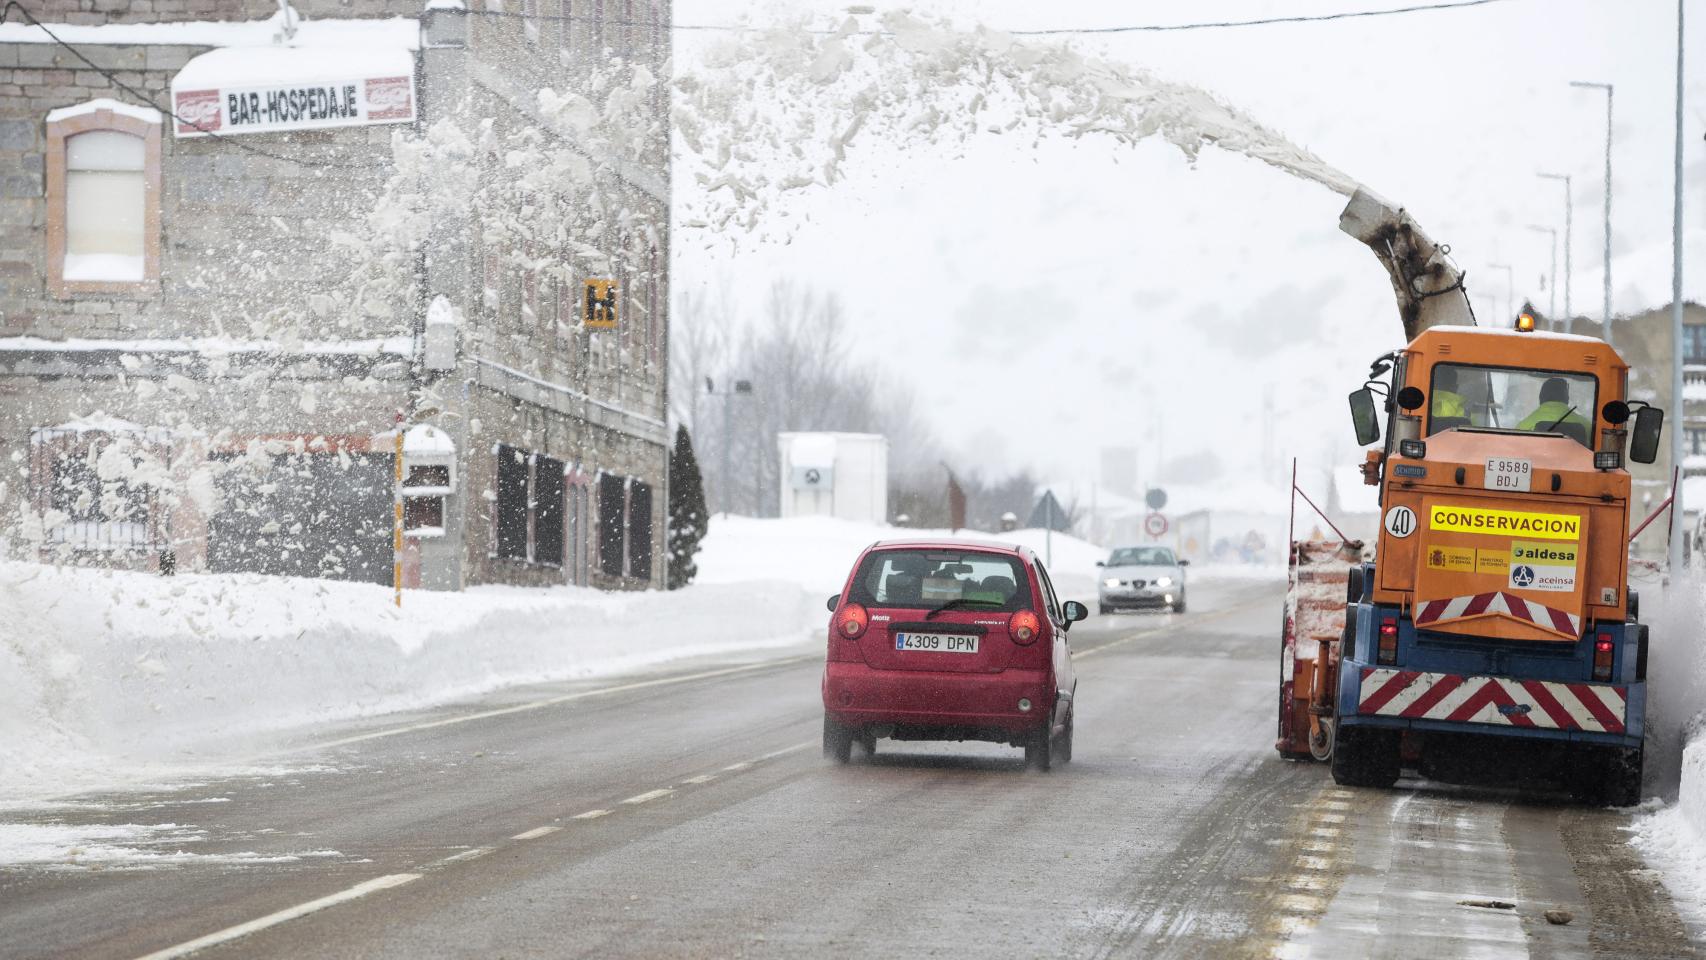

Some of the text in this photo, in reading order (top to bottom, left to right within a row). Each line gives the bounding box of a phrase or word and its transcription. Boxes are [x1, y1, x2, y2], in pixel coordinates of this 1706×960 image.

[228, 85, 358, 125] BAR-HOSPEDAJE
[1487, 460, 1529, 474] E 9589
[1496, 475, 1519, 488] BDJ
[1391, 509, 1410, 535] 40
[1433, 511, 1577, 534] CONSERVACION
[1525, 548, 1575, 560] aldesa
[1538, 576, 1574, 585] aceinsa
[905, 635, 975, 651] 4309 DPN
